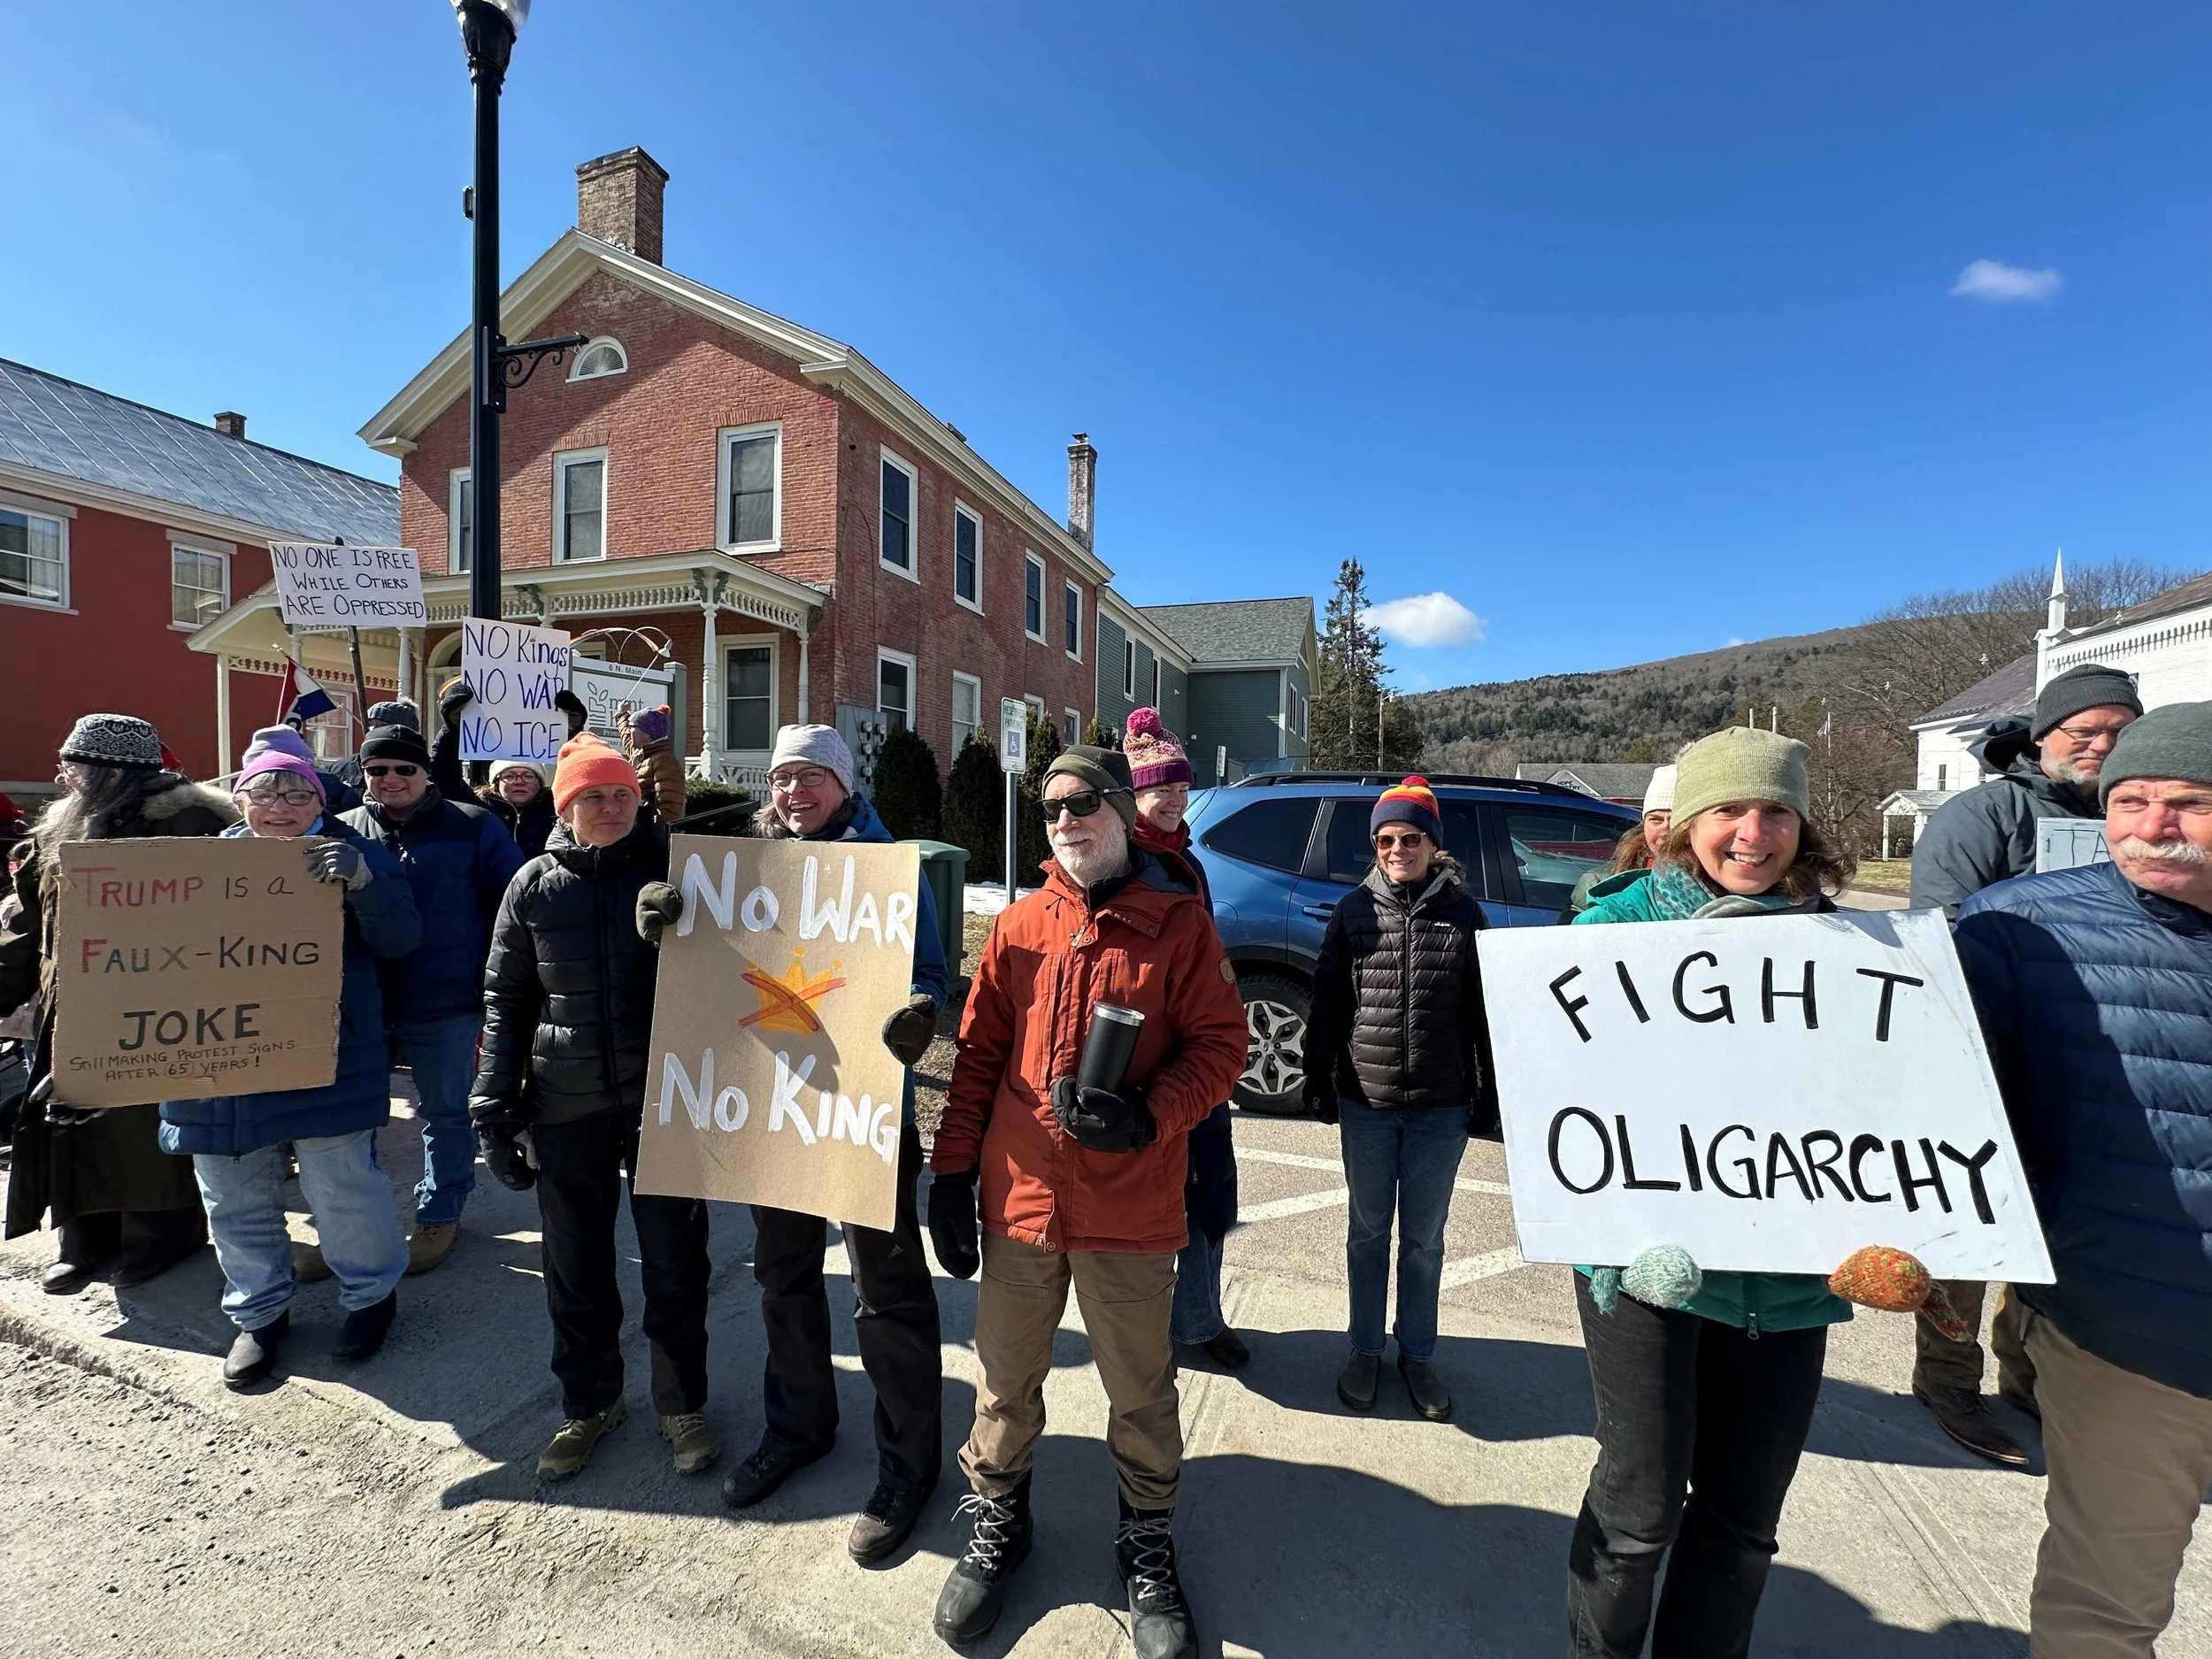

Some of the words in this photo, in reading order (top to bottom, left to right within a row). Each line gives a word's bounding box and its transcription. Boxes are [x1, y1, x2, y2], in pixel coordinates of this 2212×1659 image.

[272, 545, 297, 568] NO
[305, 547, 342, 569] ONE
[349, 549, 373, 566] IS
[375, 550, 414, 570] FREE
[291, 572, 349, 591] WHILE
[356, 573, 409, 589] OTHERS
[285, 594, 326, 616] ARE
[334, 594, 424, 618] OPPRESSED
[465, 623, 510, 659] NO
[517, 629, 568, 680] Kings
[465, 668, 507, 705] NO
[625, 666, 642, 676] Main
[609, 697, 644, 711] mnt
[463, 717, 503, 753] NO
[511, 721, 563, 759] ICE
[71, 867, 204, 908] TRUMP
[798, 854, 916, 955] WAR
[81, 936, 319, 973] FAUX-KING
[1548, 949, 1924, 1043] FIGHT
[118, 1002, 262, 1051] JOKE
[177, 1046, 237, 1060] PROTEST
[248, 1040, 296, 1054] SIGNS
[105, 1068, 160, 1082] AFTER
[167, 1063, 188, 1076] 65
[768, 1050, 898, 1167] KING
[1548, 1106, 1998, 1225] OLIGARCHY
